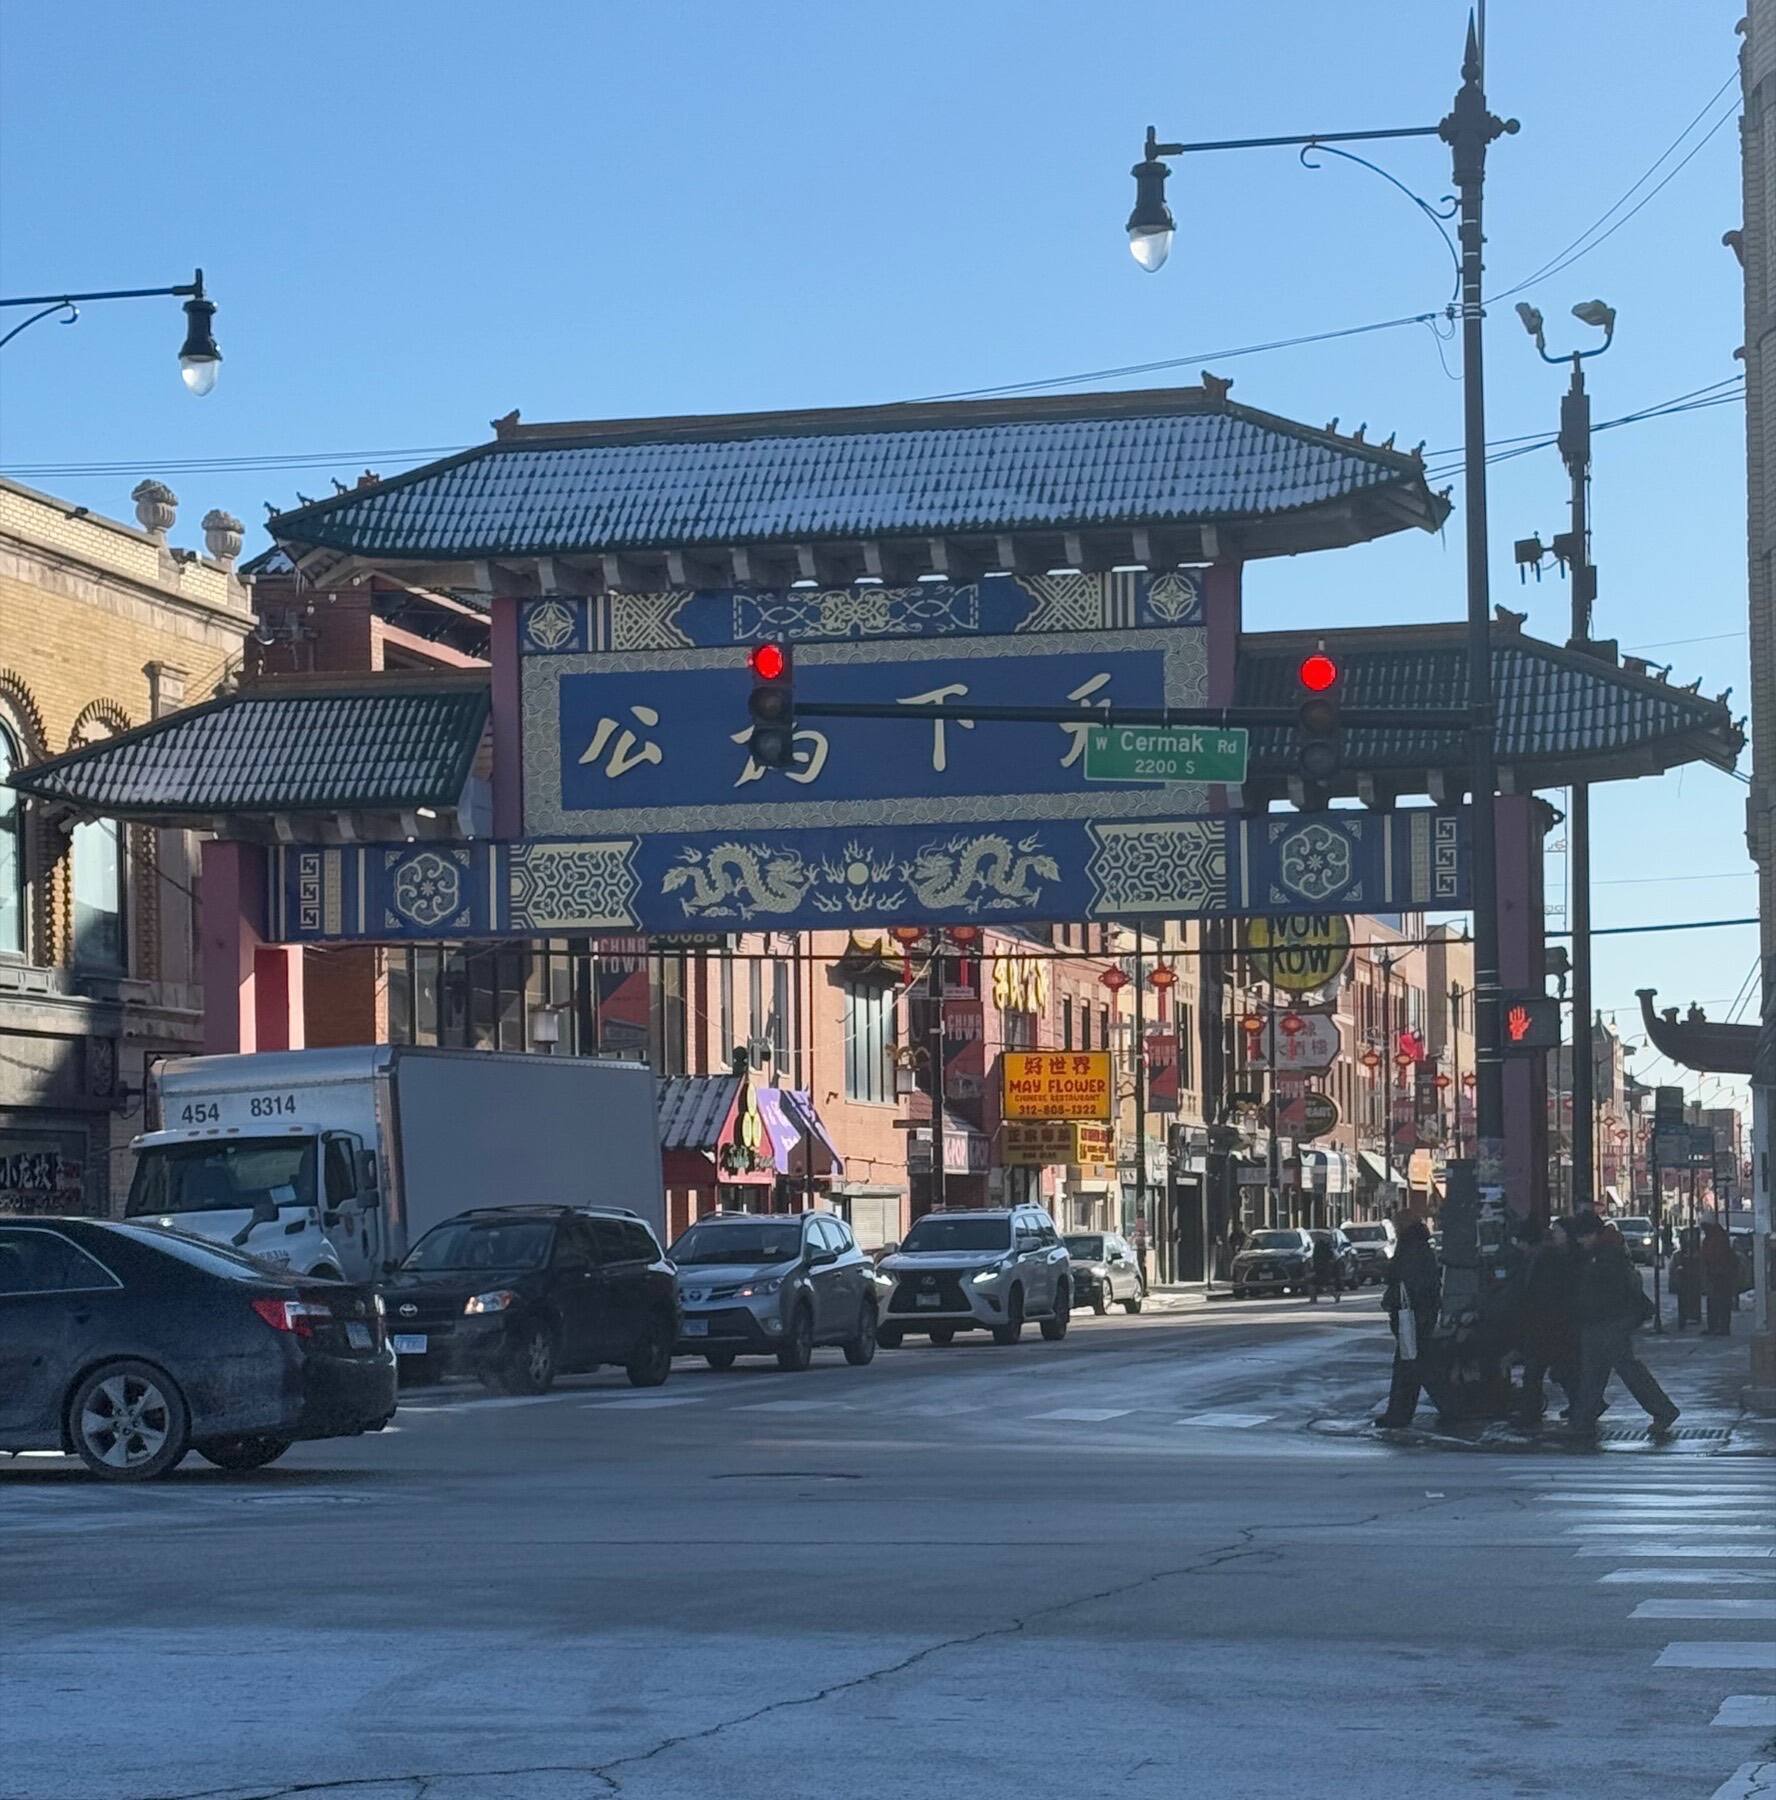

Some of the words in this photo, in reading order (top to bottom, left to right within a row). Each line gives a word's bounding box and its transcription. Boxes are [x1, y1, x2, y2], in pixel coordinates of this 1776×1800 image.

[1096, 736, 1108, 750] W
[1120, 731, 1204, 753] Cermak
[1217, 739, 1237, 754] Rd
[1135, 760, 1177, 774] 2200
[1185, 761, 1195, 774] S
[601, 938, 646, 953] CHINA
[601, 956, 647, 974] TOWN
[1024, 1056, 1091, 1075] 好世界
[1009, 1080, 1041, 1093] MAY
[1048, 1079, 1106, 1093] FLOWER
[181, 1103, 220, 1124] 454
[250, 1095, 296, 1117] 8314
